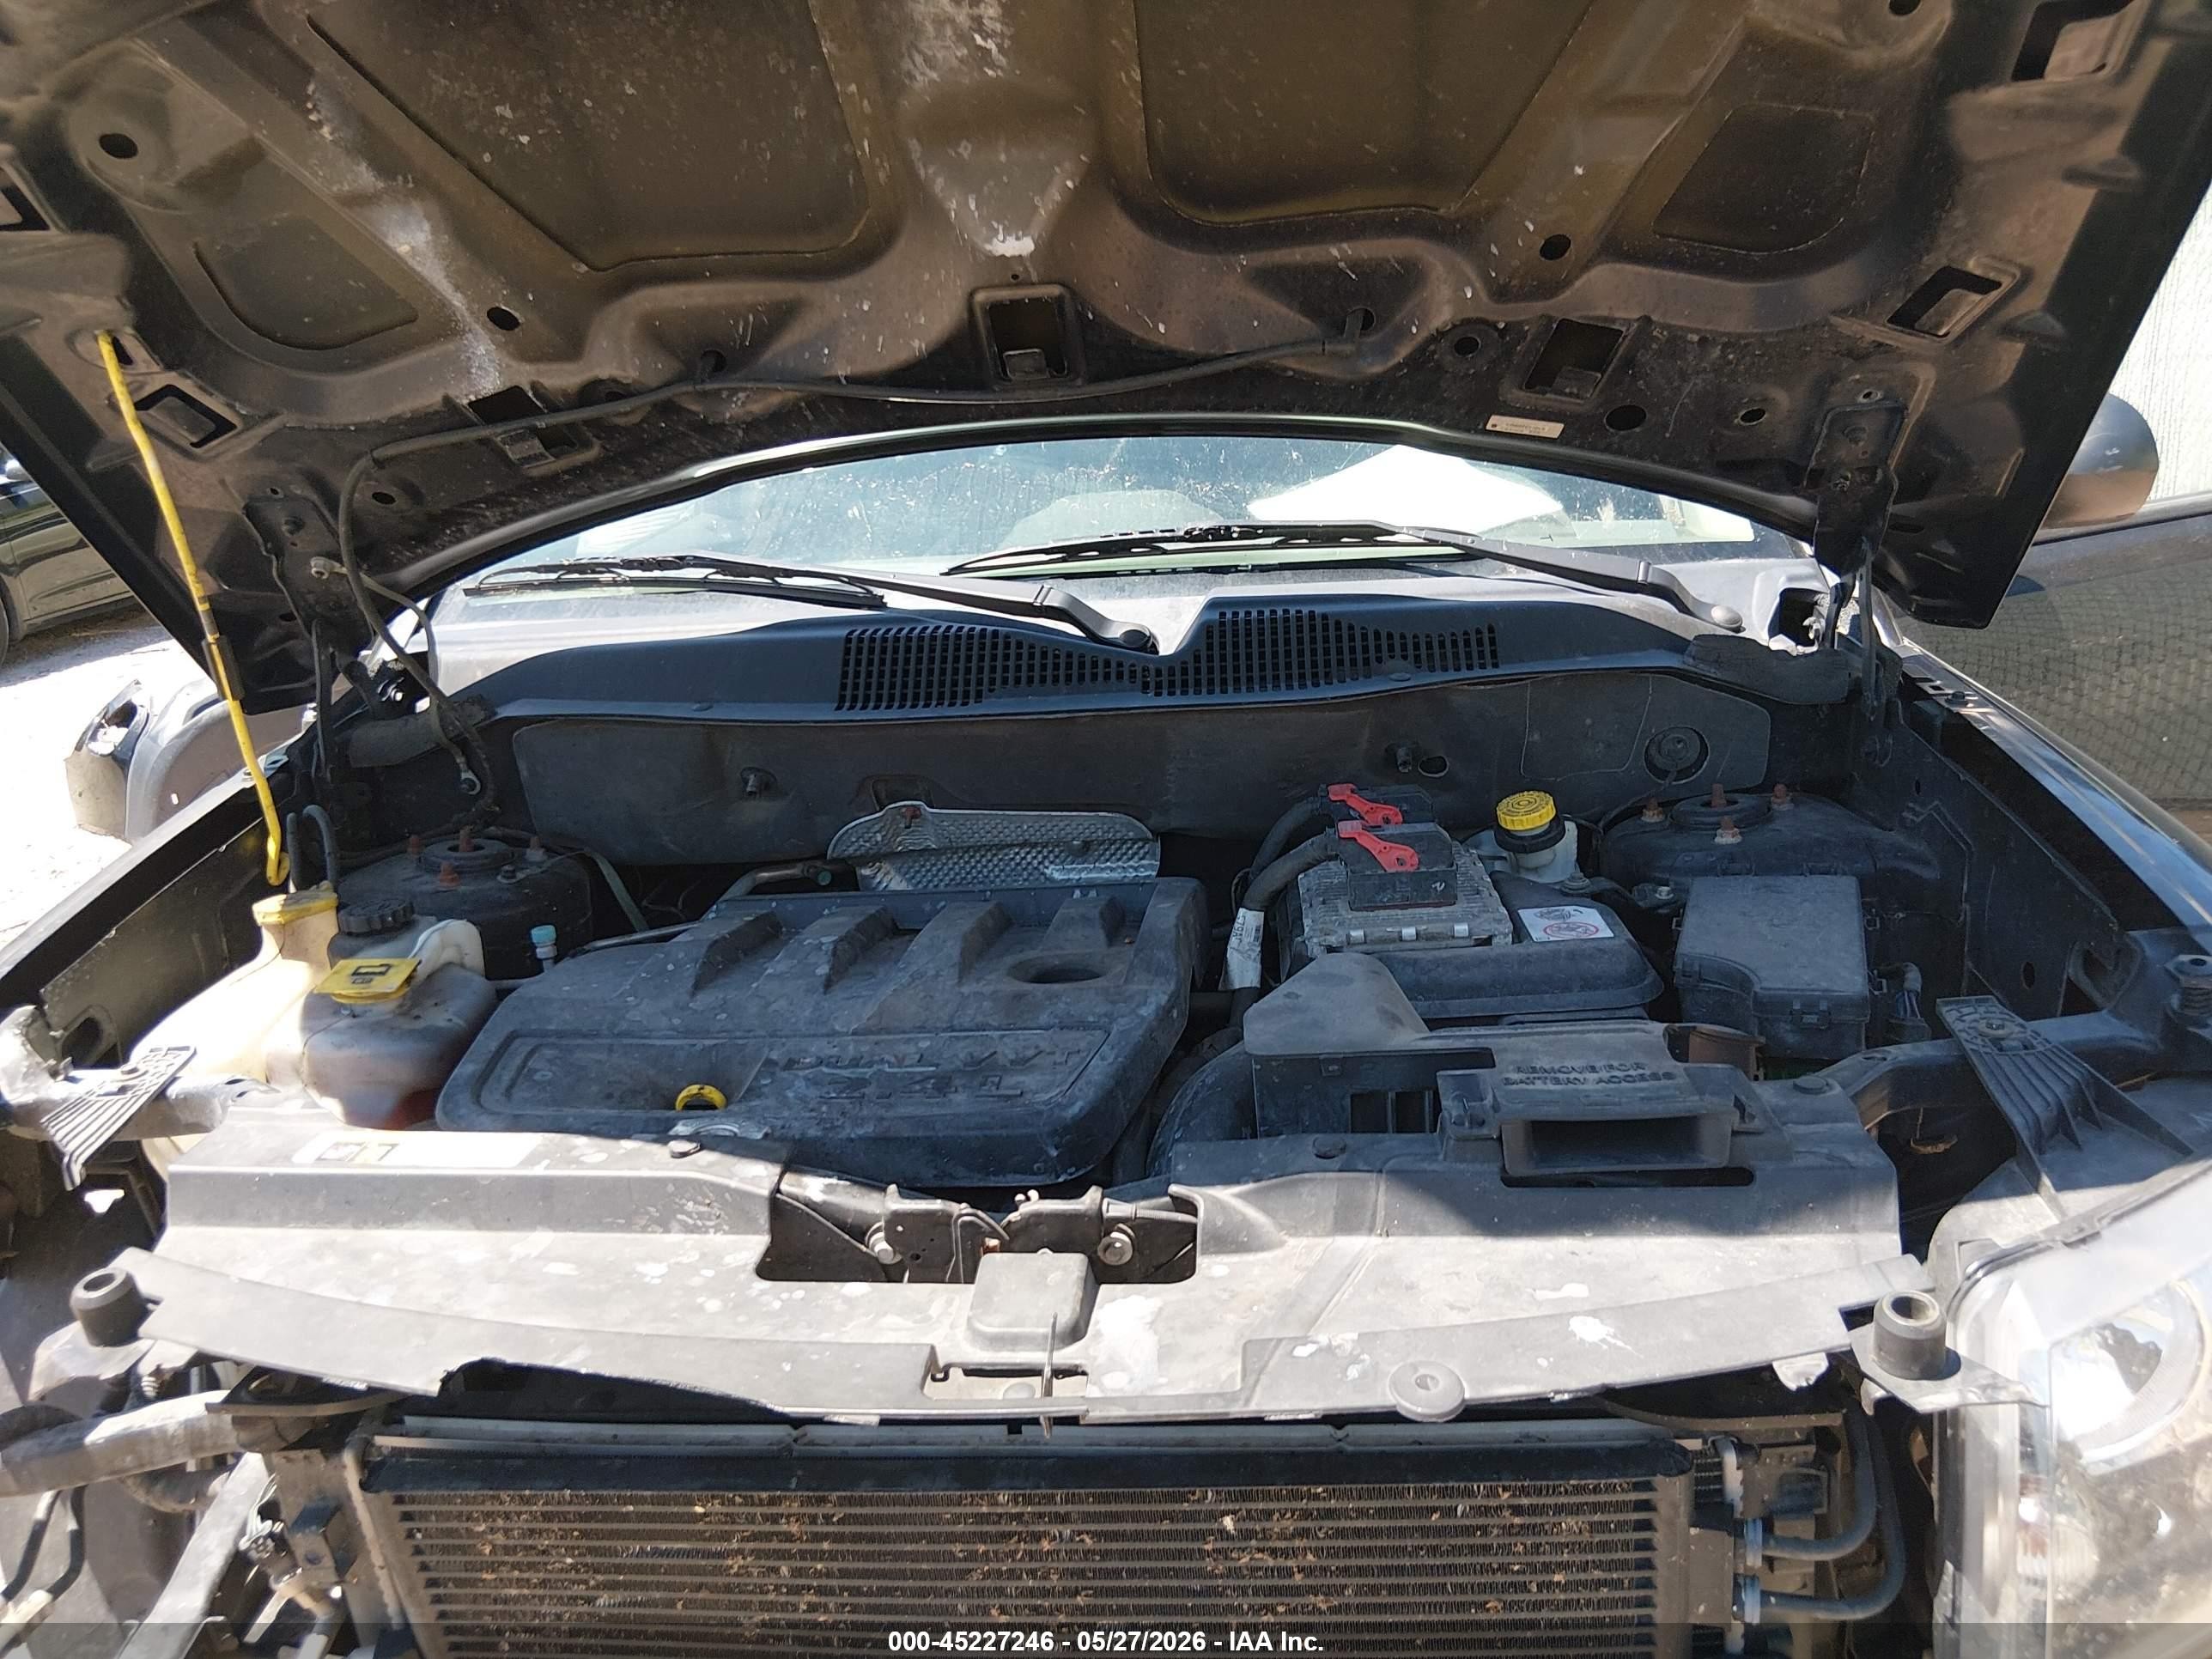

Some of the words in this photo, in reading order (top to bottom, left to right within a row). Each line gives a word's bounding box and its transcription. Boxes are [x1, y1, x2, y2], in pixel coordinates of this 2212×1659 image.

[1515, 1064, 1599, 1074] REMOVE
[1601, 1061, 1648, 1073] FOR
[1502, 1076, 1587, 1086] BATTERY
[1595, 1071, 1677, 1085] ACCESS
